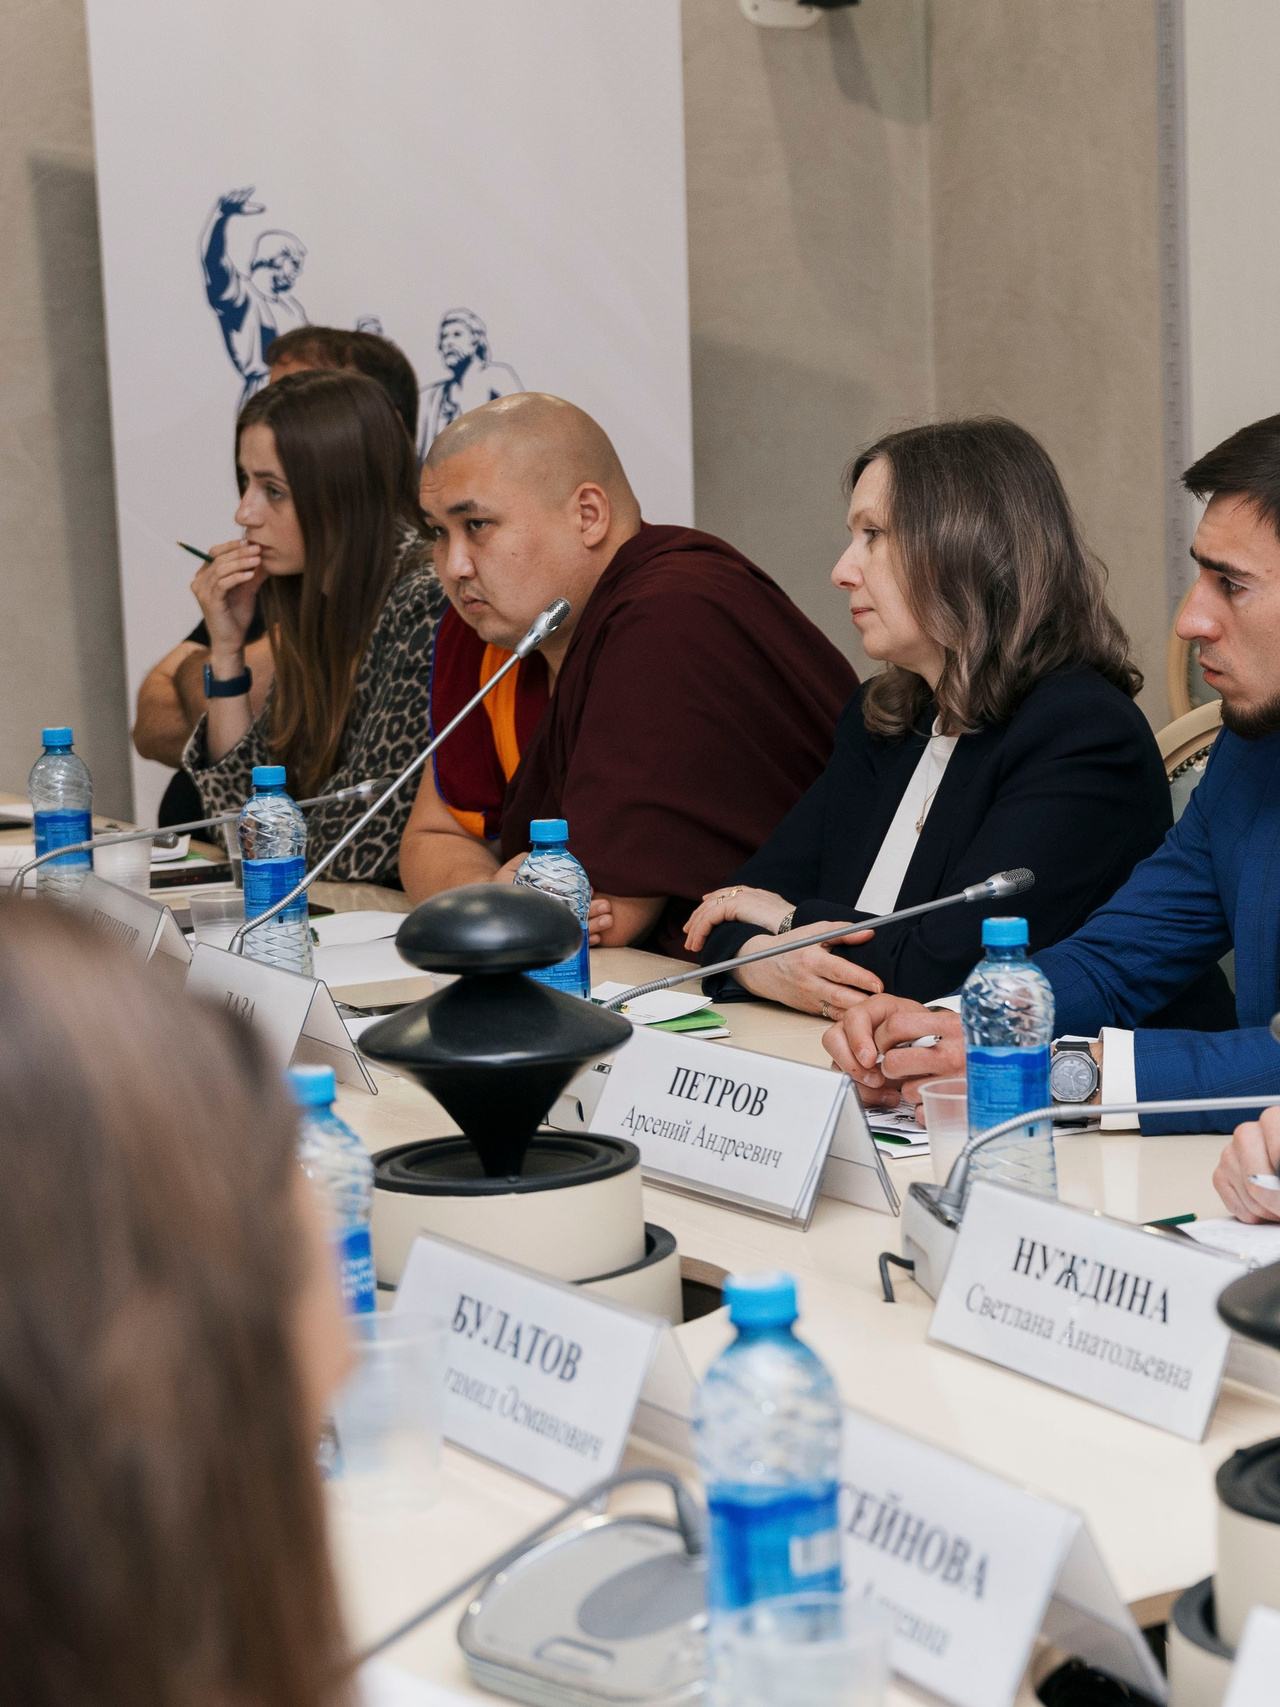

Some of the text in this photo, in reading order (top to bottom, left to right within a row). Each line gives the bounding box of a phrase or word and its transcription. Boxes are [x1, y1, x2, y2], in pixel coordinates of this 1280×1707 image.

[667, 1065, 769, 1117] ПЕТРОВ
[620, 1105, 784, 1169] Арсений Андреевич
[1012, 1236, 1169, 1324] НУЖДИНА
[452, 1293, 584, 1384] БУЛАТОВ
[965, 1281, 1194, 1391] Светлана Анатольевна
[840, 1480, 991, 1600] ЕЙНОВА
